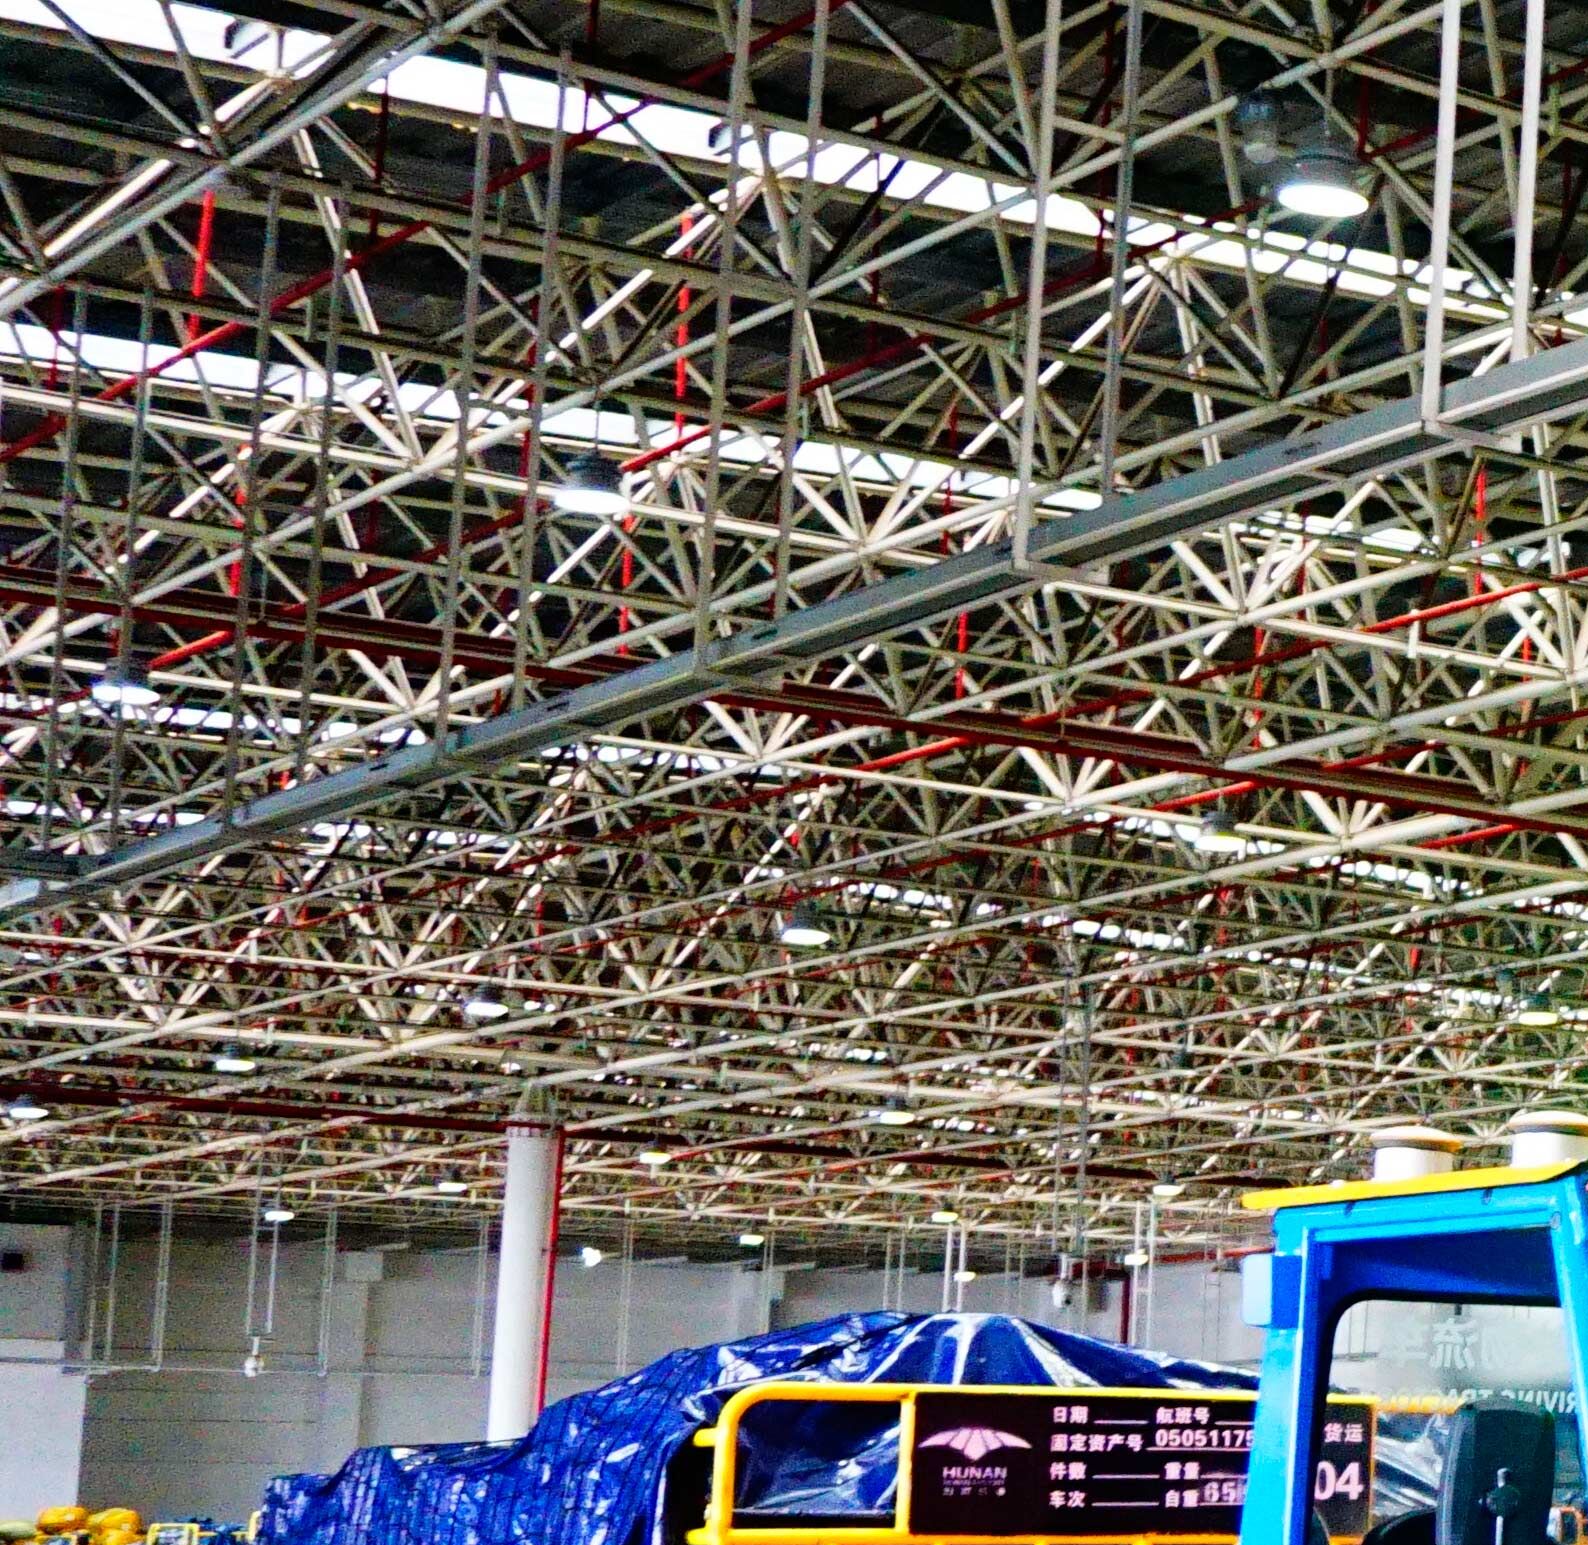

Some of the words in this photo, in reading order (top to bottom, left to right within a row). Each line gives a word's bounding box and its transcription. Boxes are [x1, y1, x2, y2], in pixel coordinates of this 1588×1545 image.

[1053, 1406, 1088, 1424] 日期
[1156, 1407, 1210, 1425] 航班号
[1050, 1434, 1144, 1452] 固定资产号
[943, 1467, 1007, 1479] HUNAN
[1050, 1462, 1087, 1480] 件数
[1050, 1490, 1086, 1508] 车次
[1165, 1489, 1199, 1508] 自重
